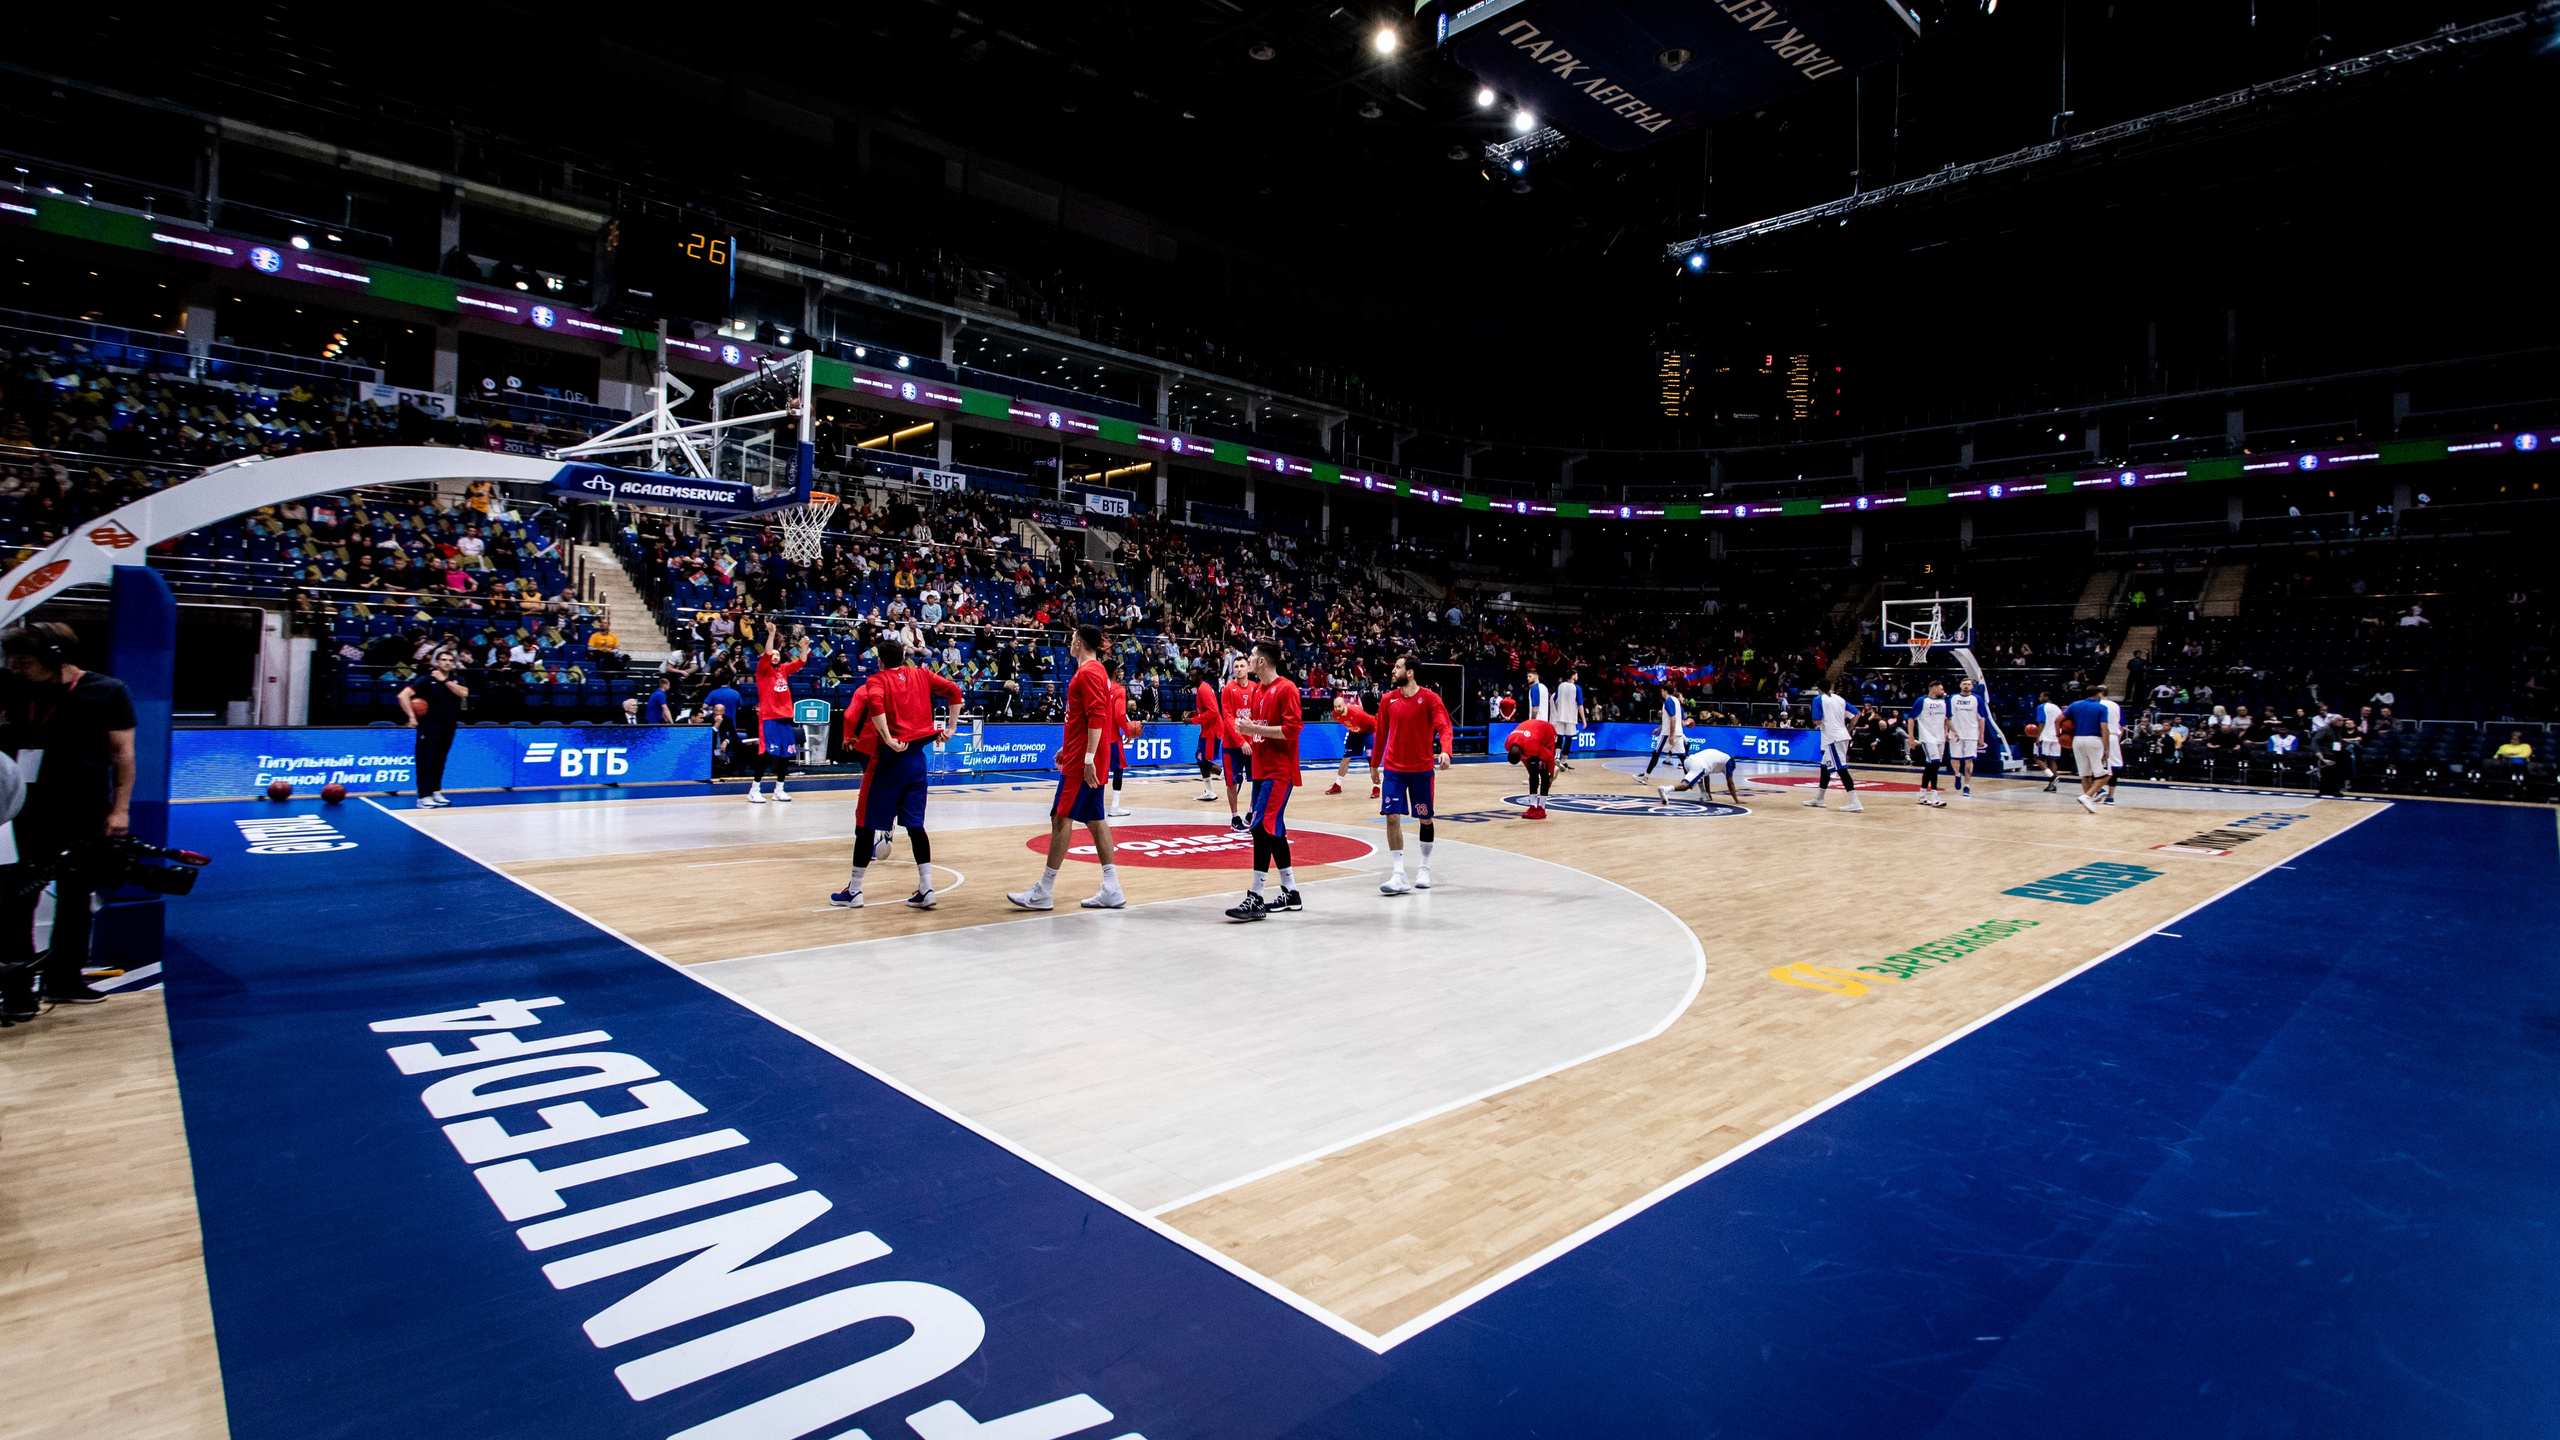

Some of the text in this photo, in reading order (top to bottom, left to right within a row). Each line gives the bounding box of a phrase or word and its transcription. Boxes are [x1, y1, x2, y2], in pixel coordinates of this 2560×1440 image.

[1498, 19, 1672, 133] ПАРК ЛЕГЕНД
[933, 473, 960, 491] ВТБ
[1102, 499, 1124, 514] ВТБ
[1579, 732, 1596, 747] ВТБ
[1757, 739, 1791, 756] ВТБ
[1136, 738, 1172, 760] ВТБ
[256, 754, 355, 772] Титульный
[560, 747, 629, 777] ВТБ
[998, 753, 1019, 764] Лиги
[1020, 753, 1038, 764] ВТБ
[329, 770, 371, 784] Лиги
[374, 769, 410, 783] ВТБ
[1415, 803, 1429, 816] 13
[2001, 862, 2166, 905] СИБУР
[1856, 918, 2041, 979] ЗАРУБЕЖНЕФТЬ
